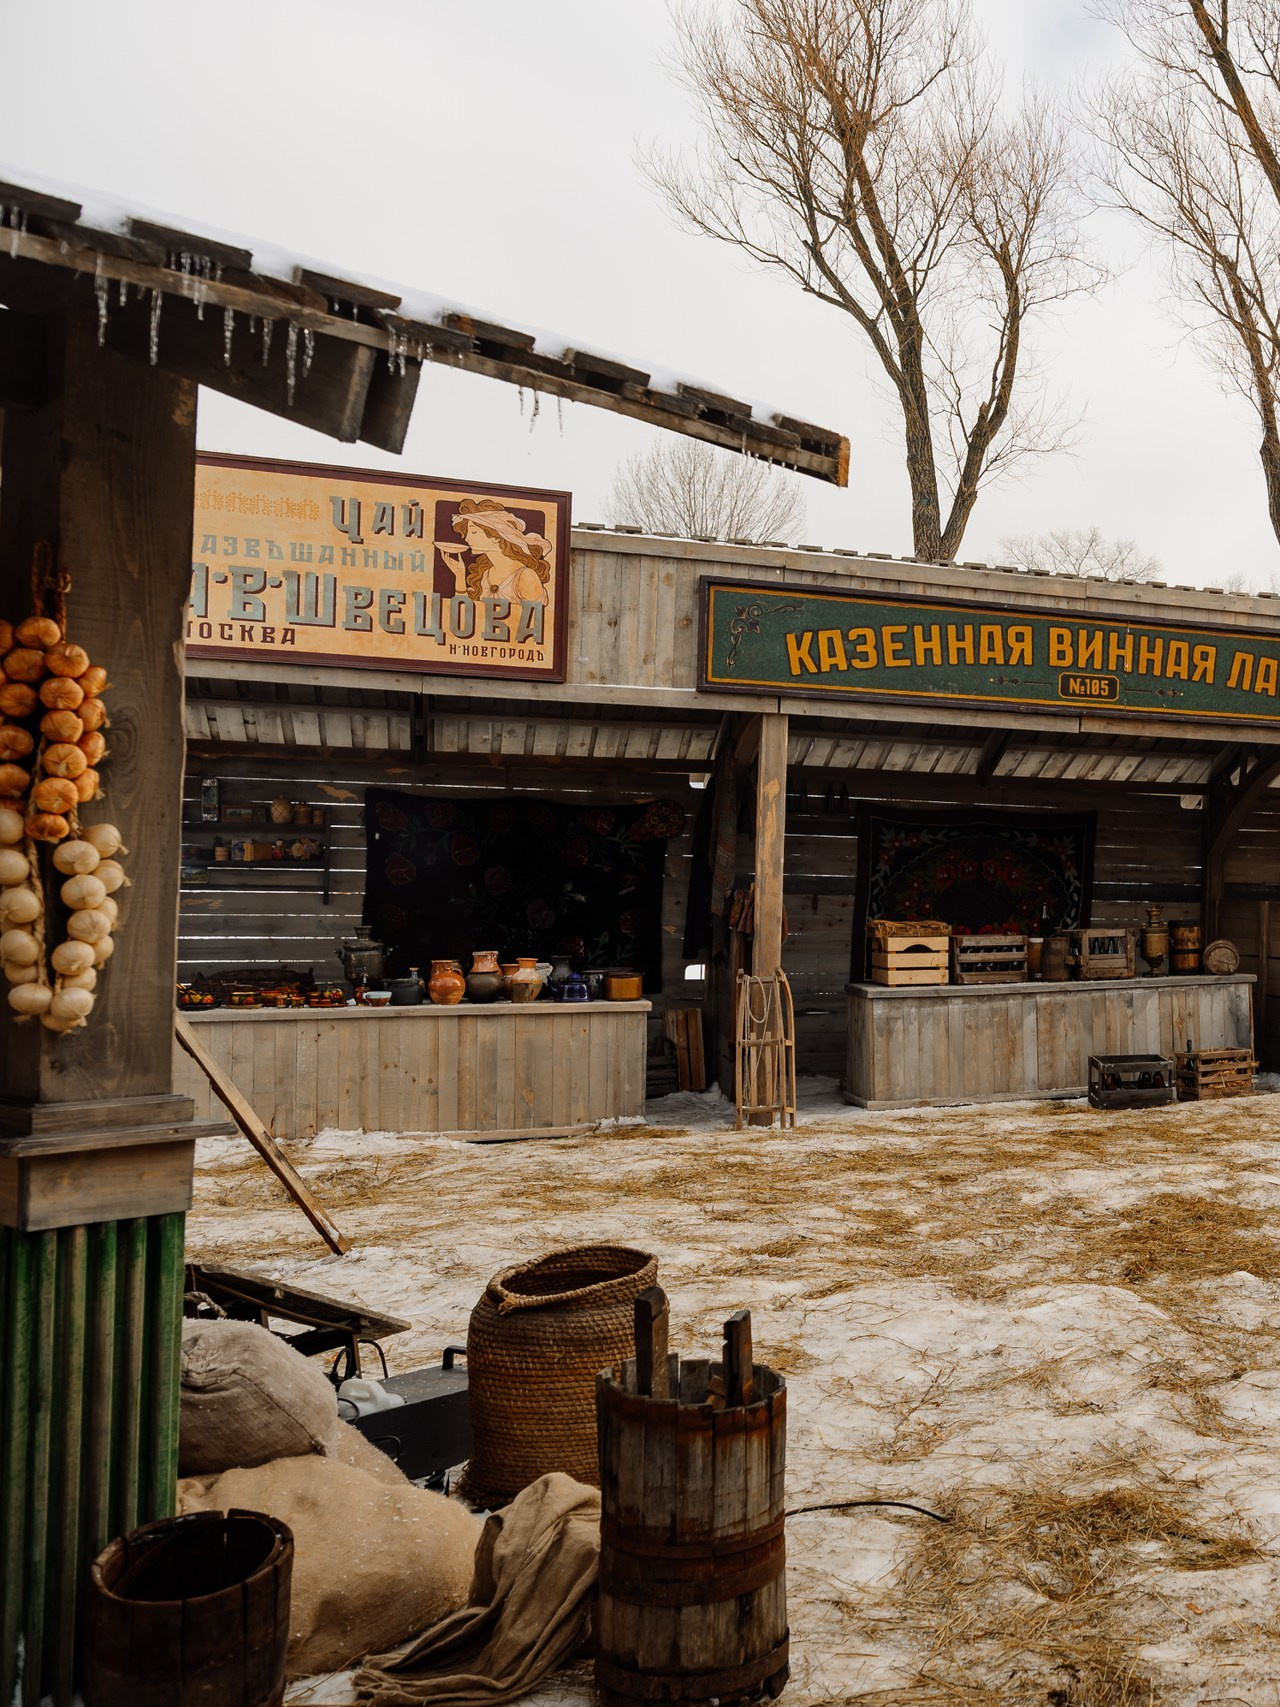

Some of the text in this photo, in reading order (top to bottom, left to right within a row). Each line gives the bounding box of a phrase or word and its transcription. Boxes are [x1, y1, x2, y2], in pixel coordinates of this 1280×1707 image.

[329, 495, 425, 544] ЧАЙ
[785, 623, 1035, 676] КАЗЕННАЯ
[1048, 625, 1217, 683] ВИННАЯ
